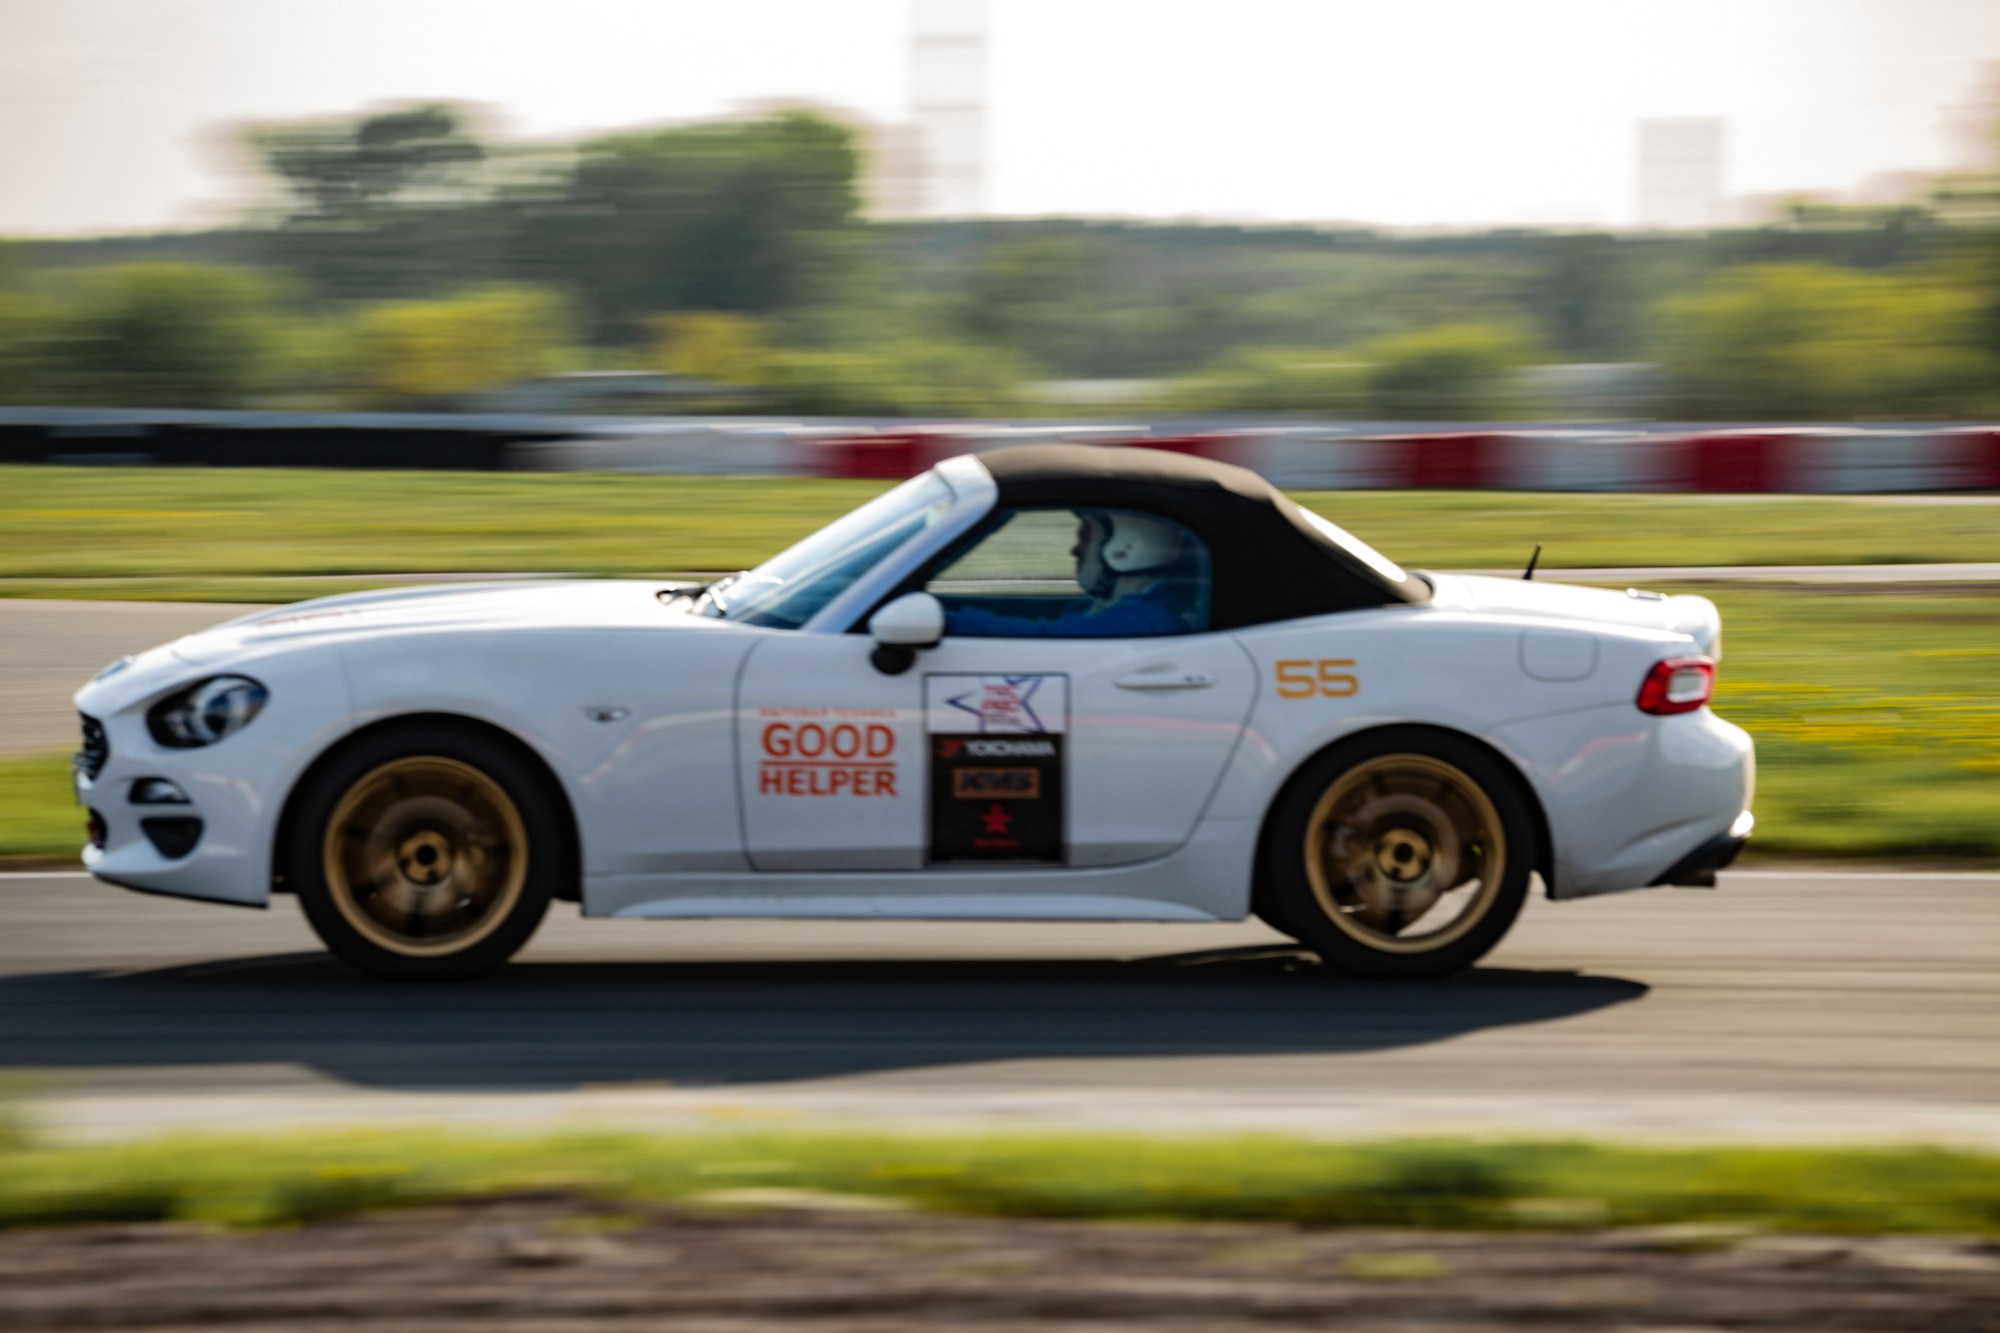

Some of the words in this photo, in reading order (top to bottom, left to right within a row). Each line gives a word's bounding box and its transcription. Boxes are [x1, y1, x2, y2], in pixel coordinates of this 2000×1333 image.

[1275, 659, 1360, 699] 55
[761, 722, 896, 758] GOOD
[759, 768, 898, 796] HELPER
